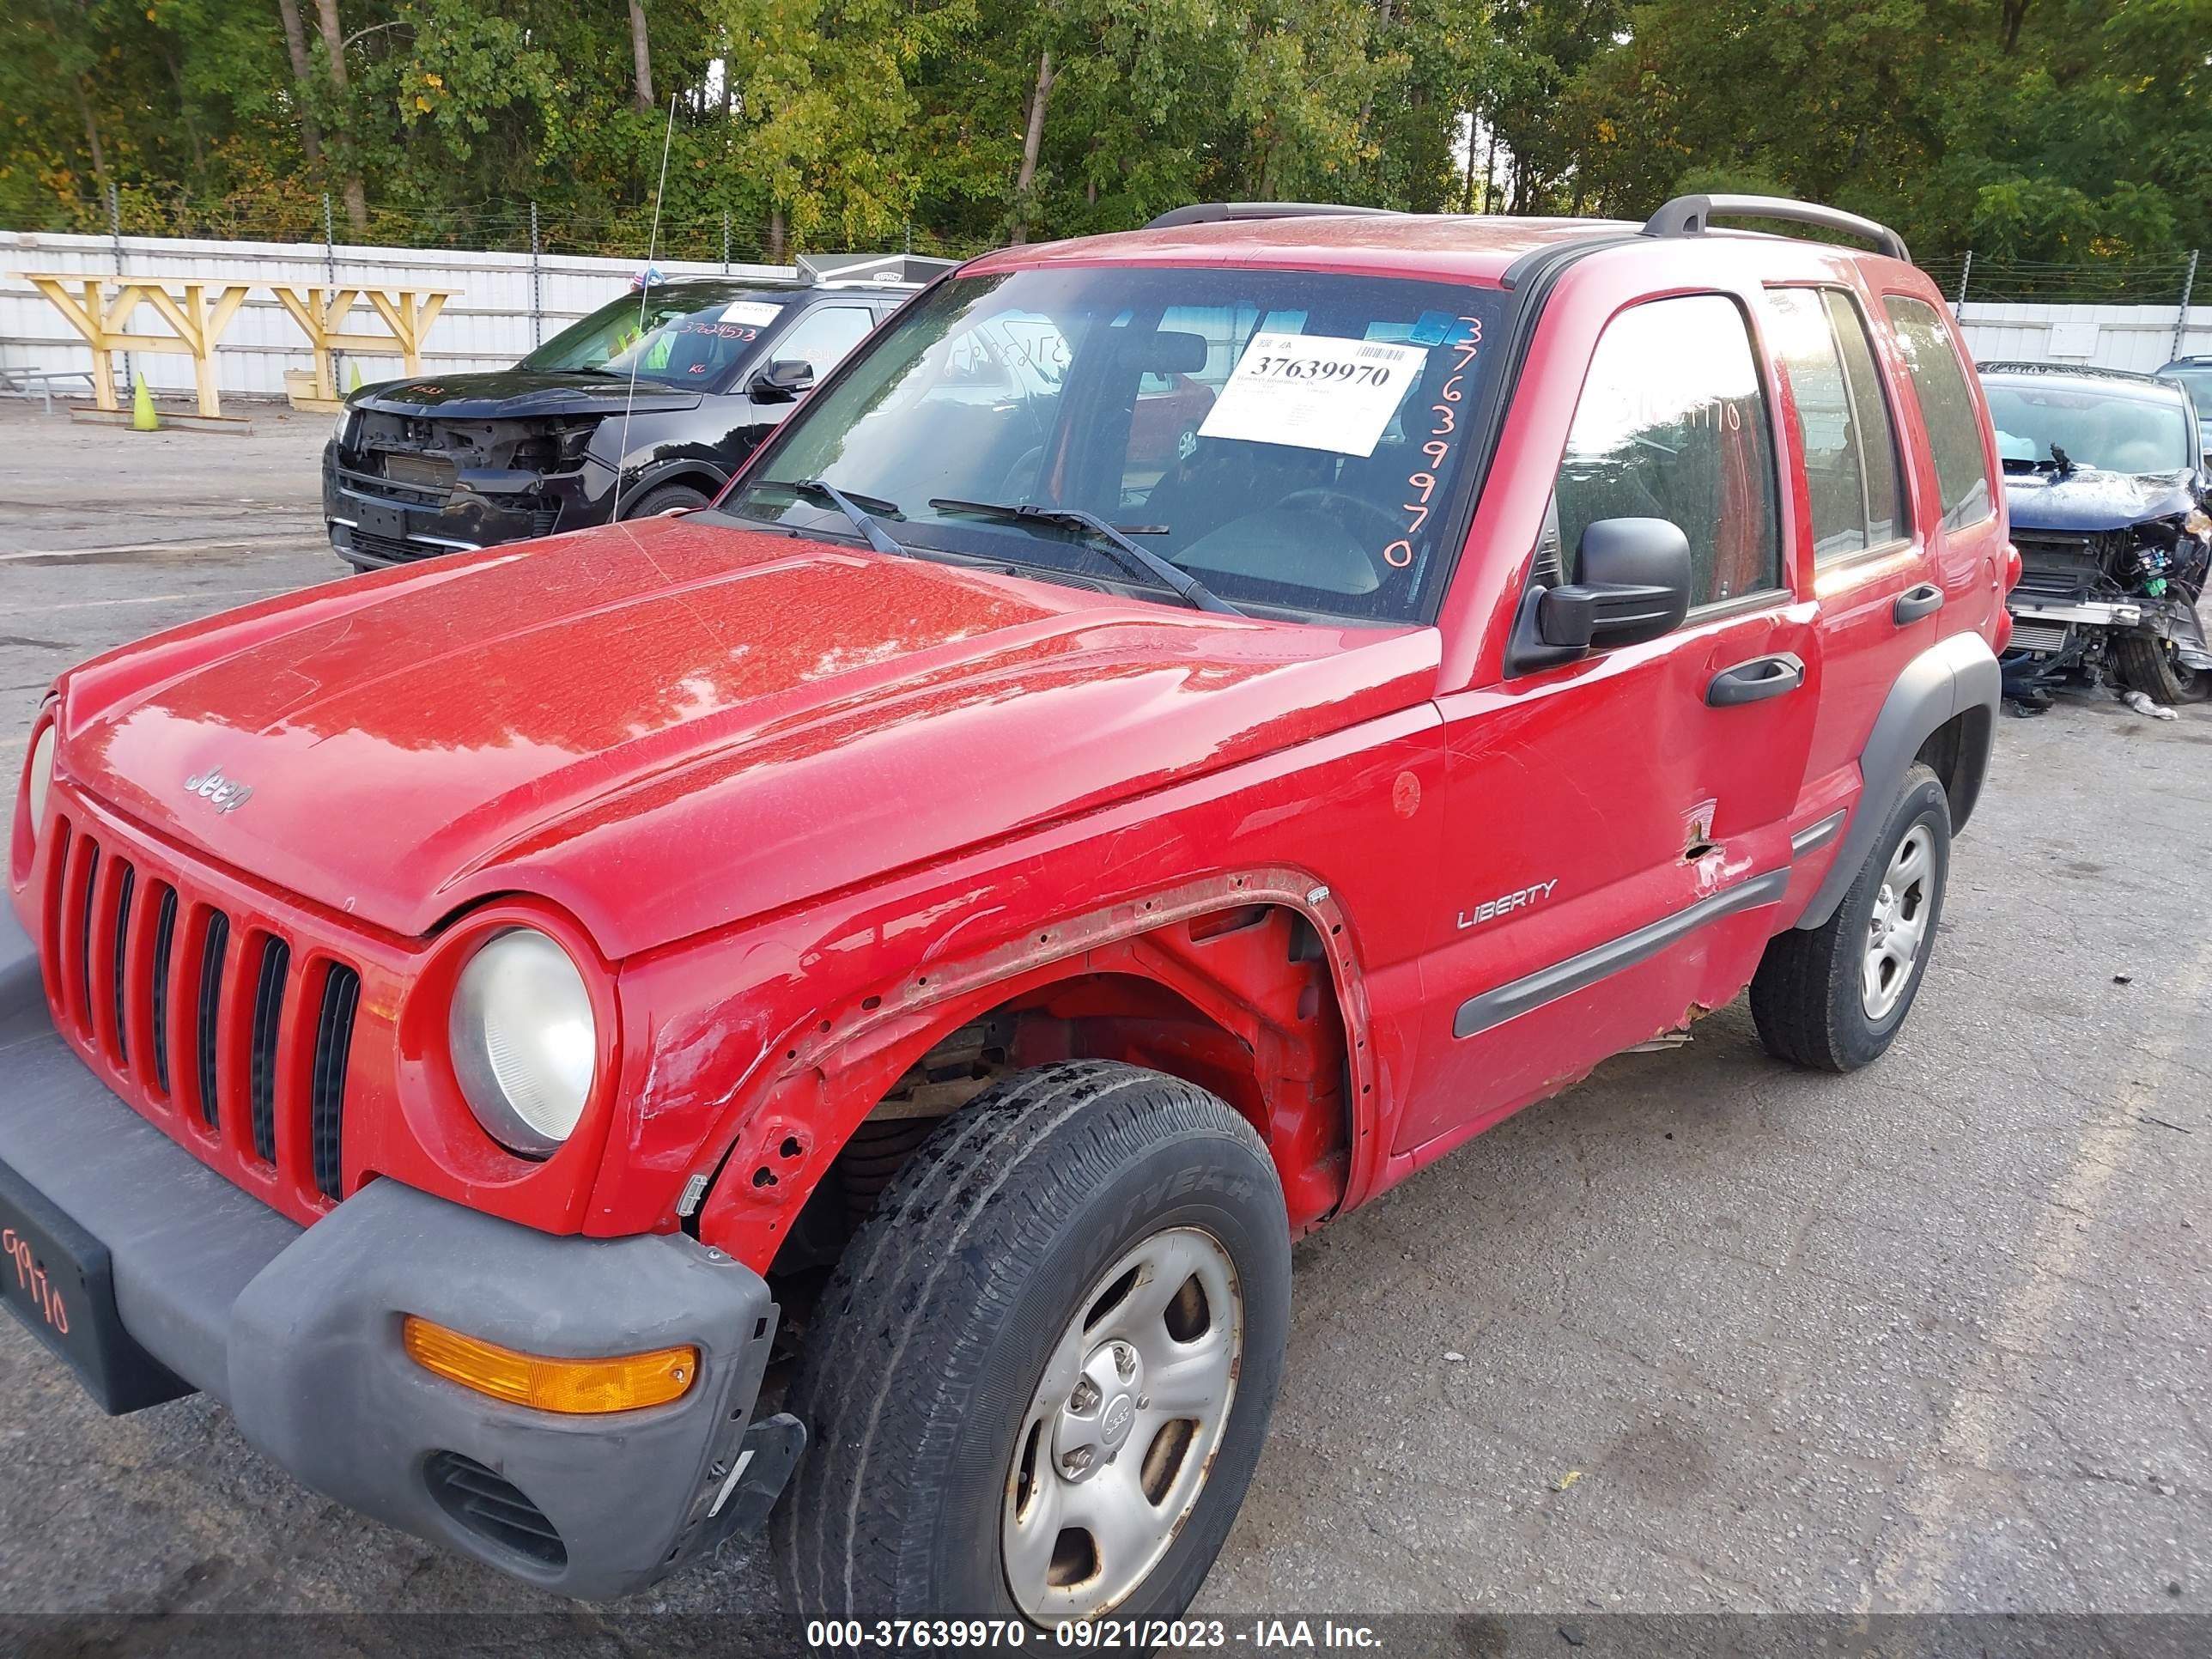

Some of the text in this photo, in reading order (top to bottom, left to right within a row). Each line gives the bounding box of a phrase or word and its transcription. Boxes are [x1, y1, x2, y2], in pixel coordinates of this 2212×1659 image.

[1250, 356, 1390, 387] 37639970
[1383, 316, 1483, 568] 37639970
[183, 763, 255, 815] Jeep
[1456, 878, 1559, 930] LIBERTY
